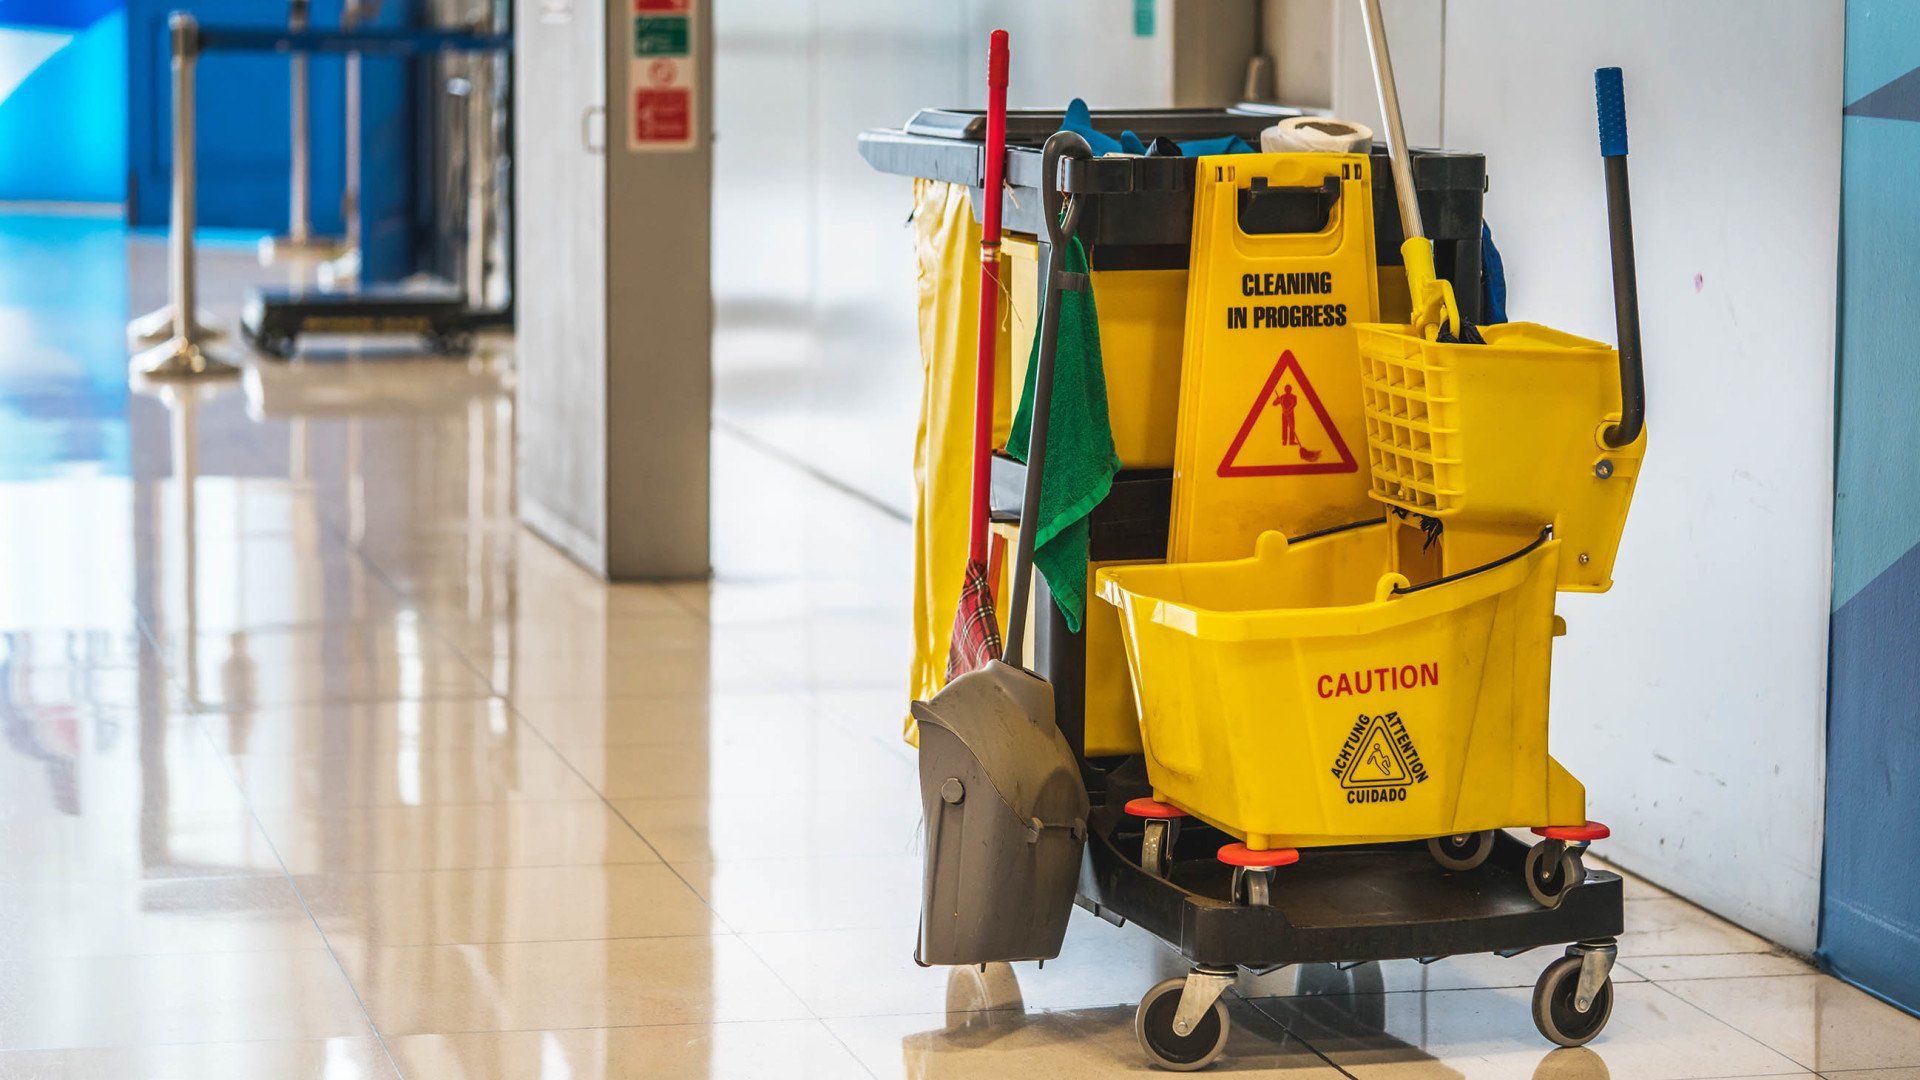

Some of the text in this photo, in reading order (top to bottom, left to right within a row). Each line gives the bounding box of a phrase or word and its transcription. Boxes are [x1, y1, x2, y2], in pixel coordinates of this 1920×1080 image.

[1242, 272, 1332, 296] CLEANING
[1227, 304, 1347, 329] IN PROGRESS
[1317, 662, 1439, 699] CAUTION
[1331, 713, 1370, 779] ACHTUNG
[1385, 711, 1429, 783] ATTENTION
[1347, 788, 1407, 804] CUIDADO
